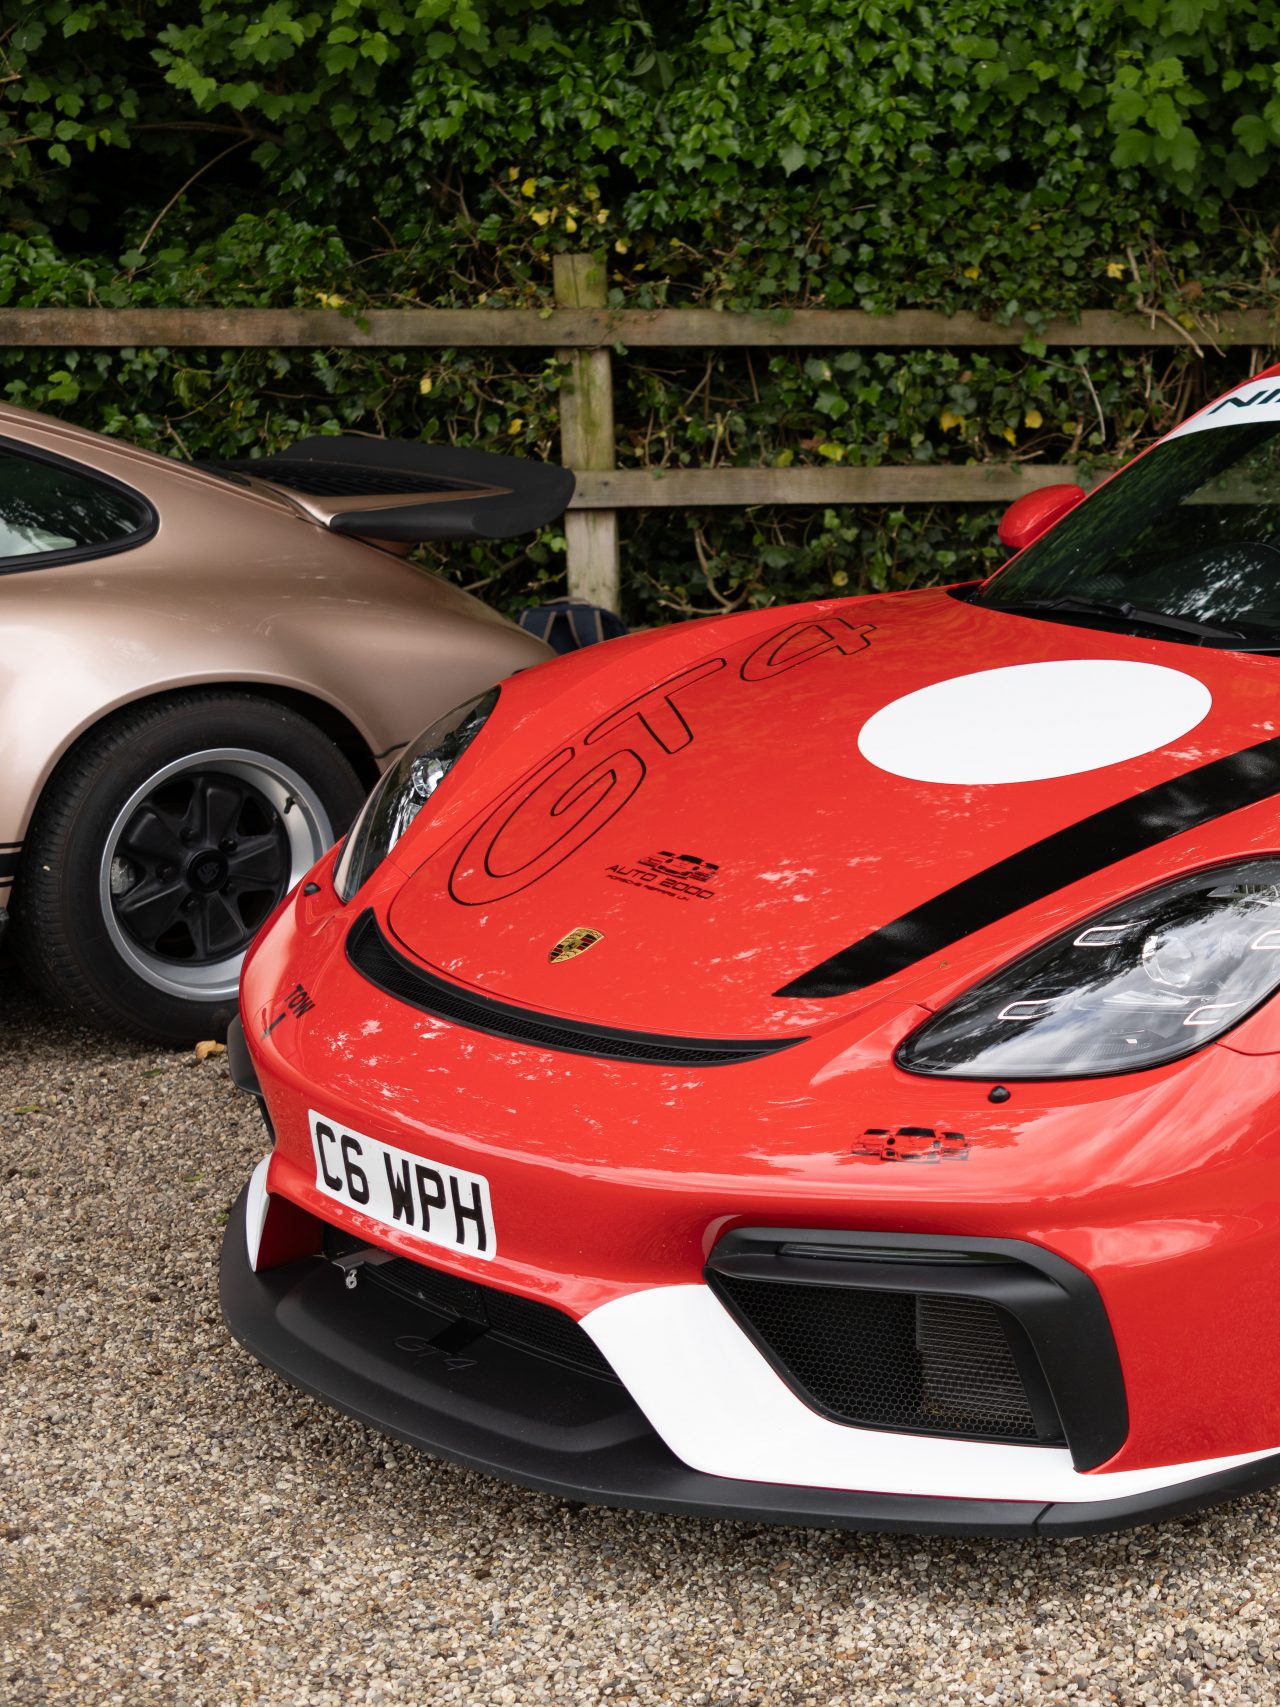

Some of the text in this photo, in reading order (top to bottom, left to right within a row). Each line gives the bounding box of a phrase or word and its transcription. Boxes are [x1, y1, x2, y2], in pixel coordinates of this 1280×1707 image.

[604, 864, 715, 900] AUTO 2000
[284, 983, 316, 1019] TOW
[315, 1121, 487, 1252] C6 WPH
